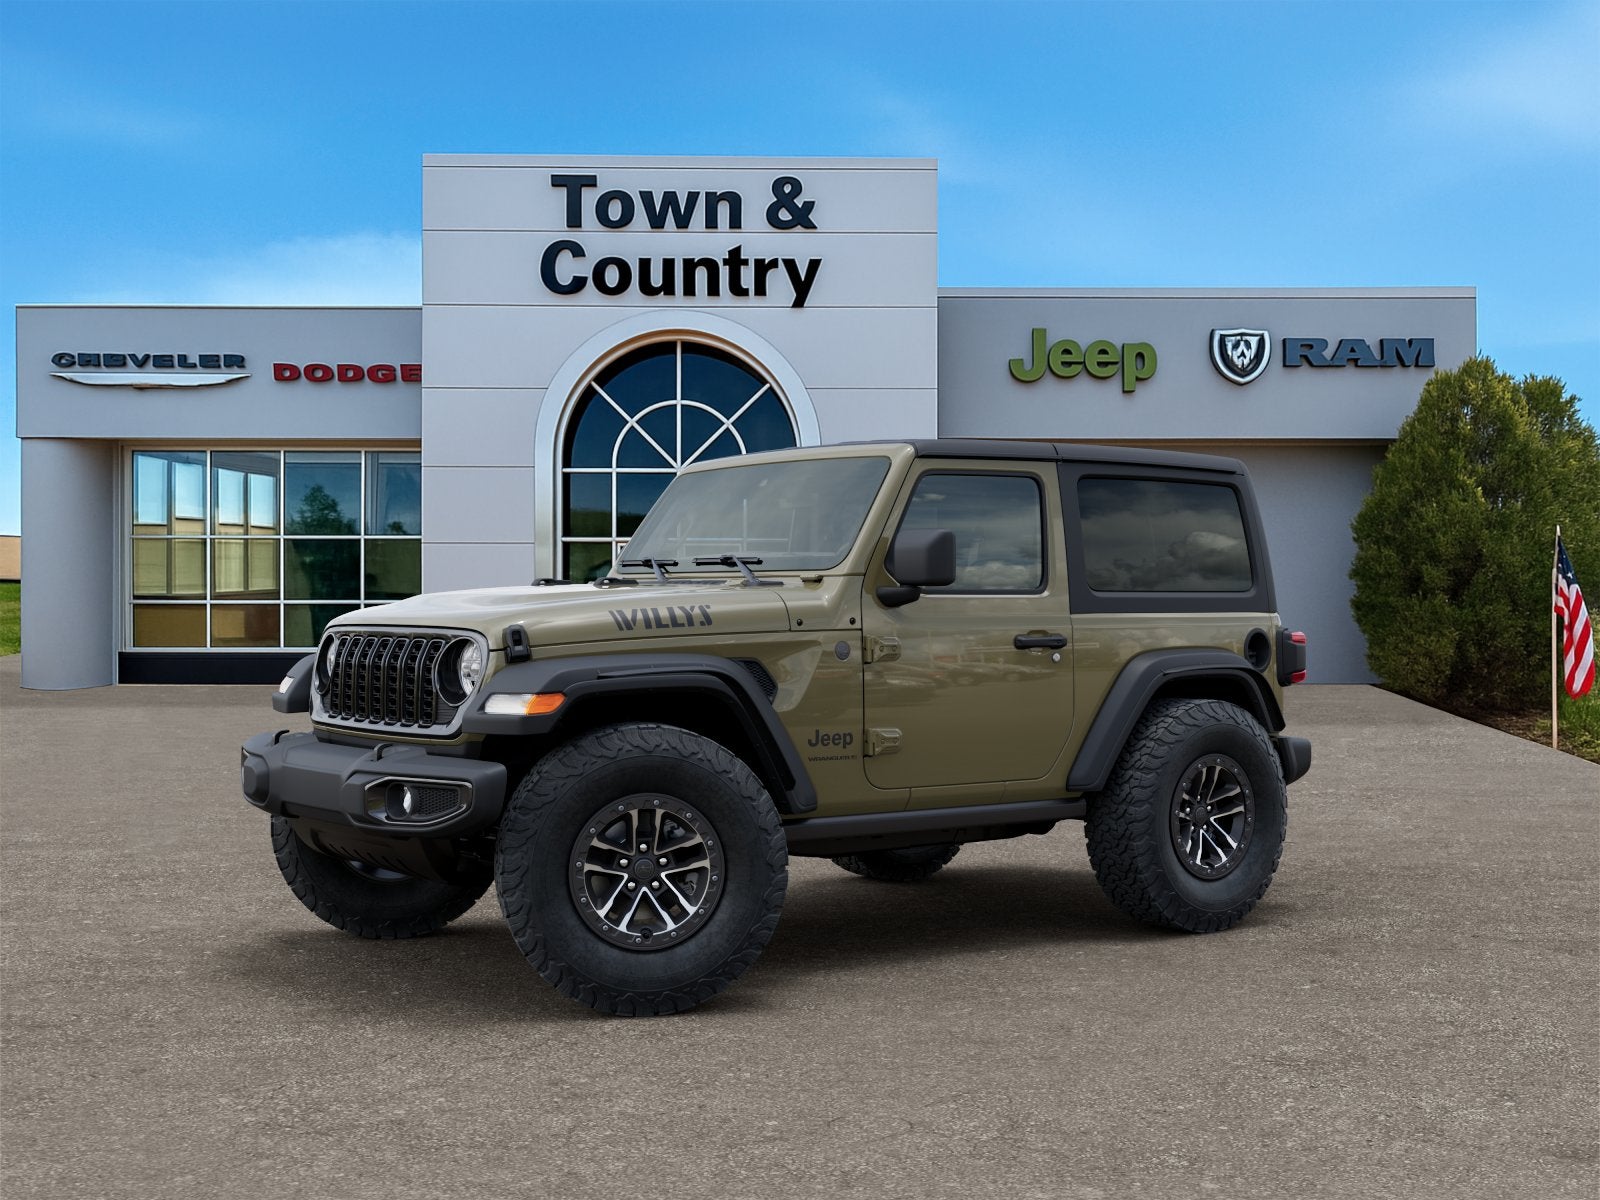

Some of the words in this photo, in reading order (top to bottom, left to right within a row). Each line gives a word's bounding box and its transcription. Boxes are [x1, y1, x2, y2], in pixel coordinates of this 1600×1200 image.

[550, 174, 743, 229] Town
[765, 175, 818, 230] &
[540, 239, 822, 308] Country
[1008, 328, 1158, 393] Jeep
[1282, 337, 1436, 367] RAM
[273, 363, 422, 383] DODGE
[608, 604, 713, 631] WILLYS
[808, 729, 854, 749] Jeep
